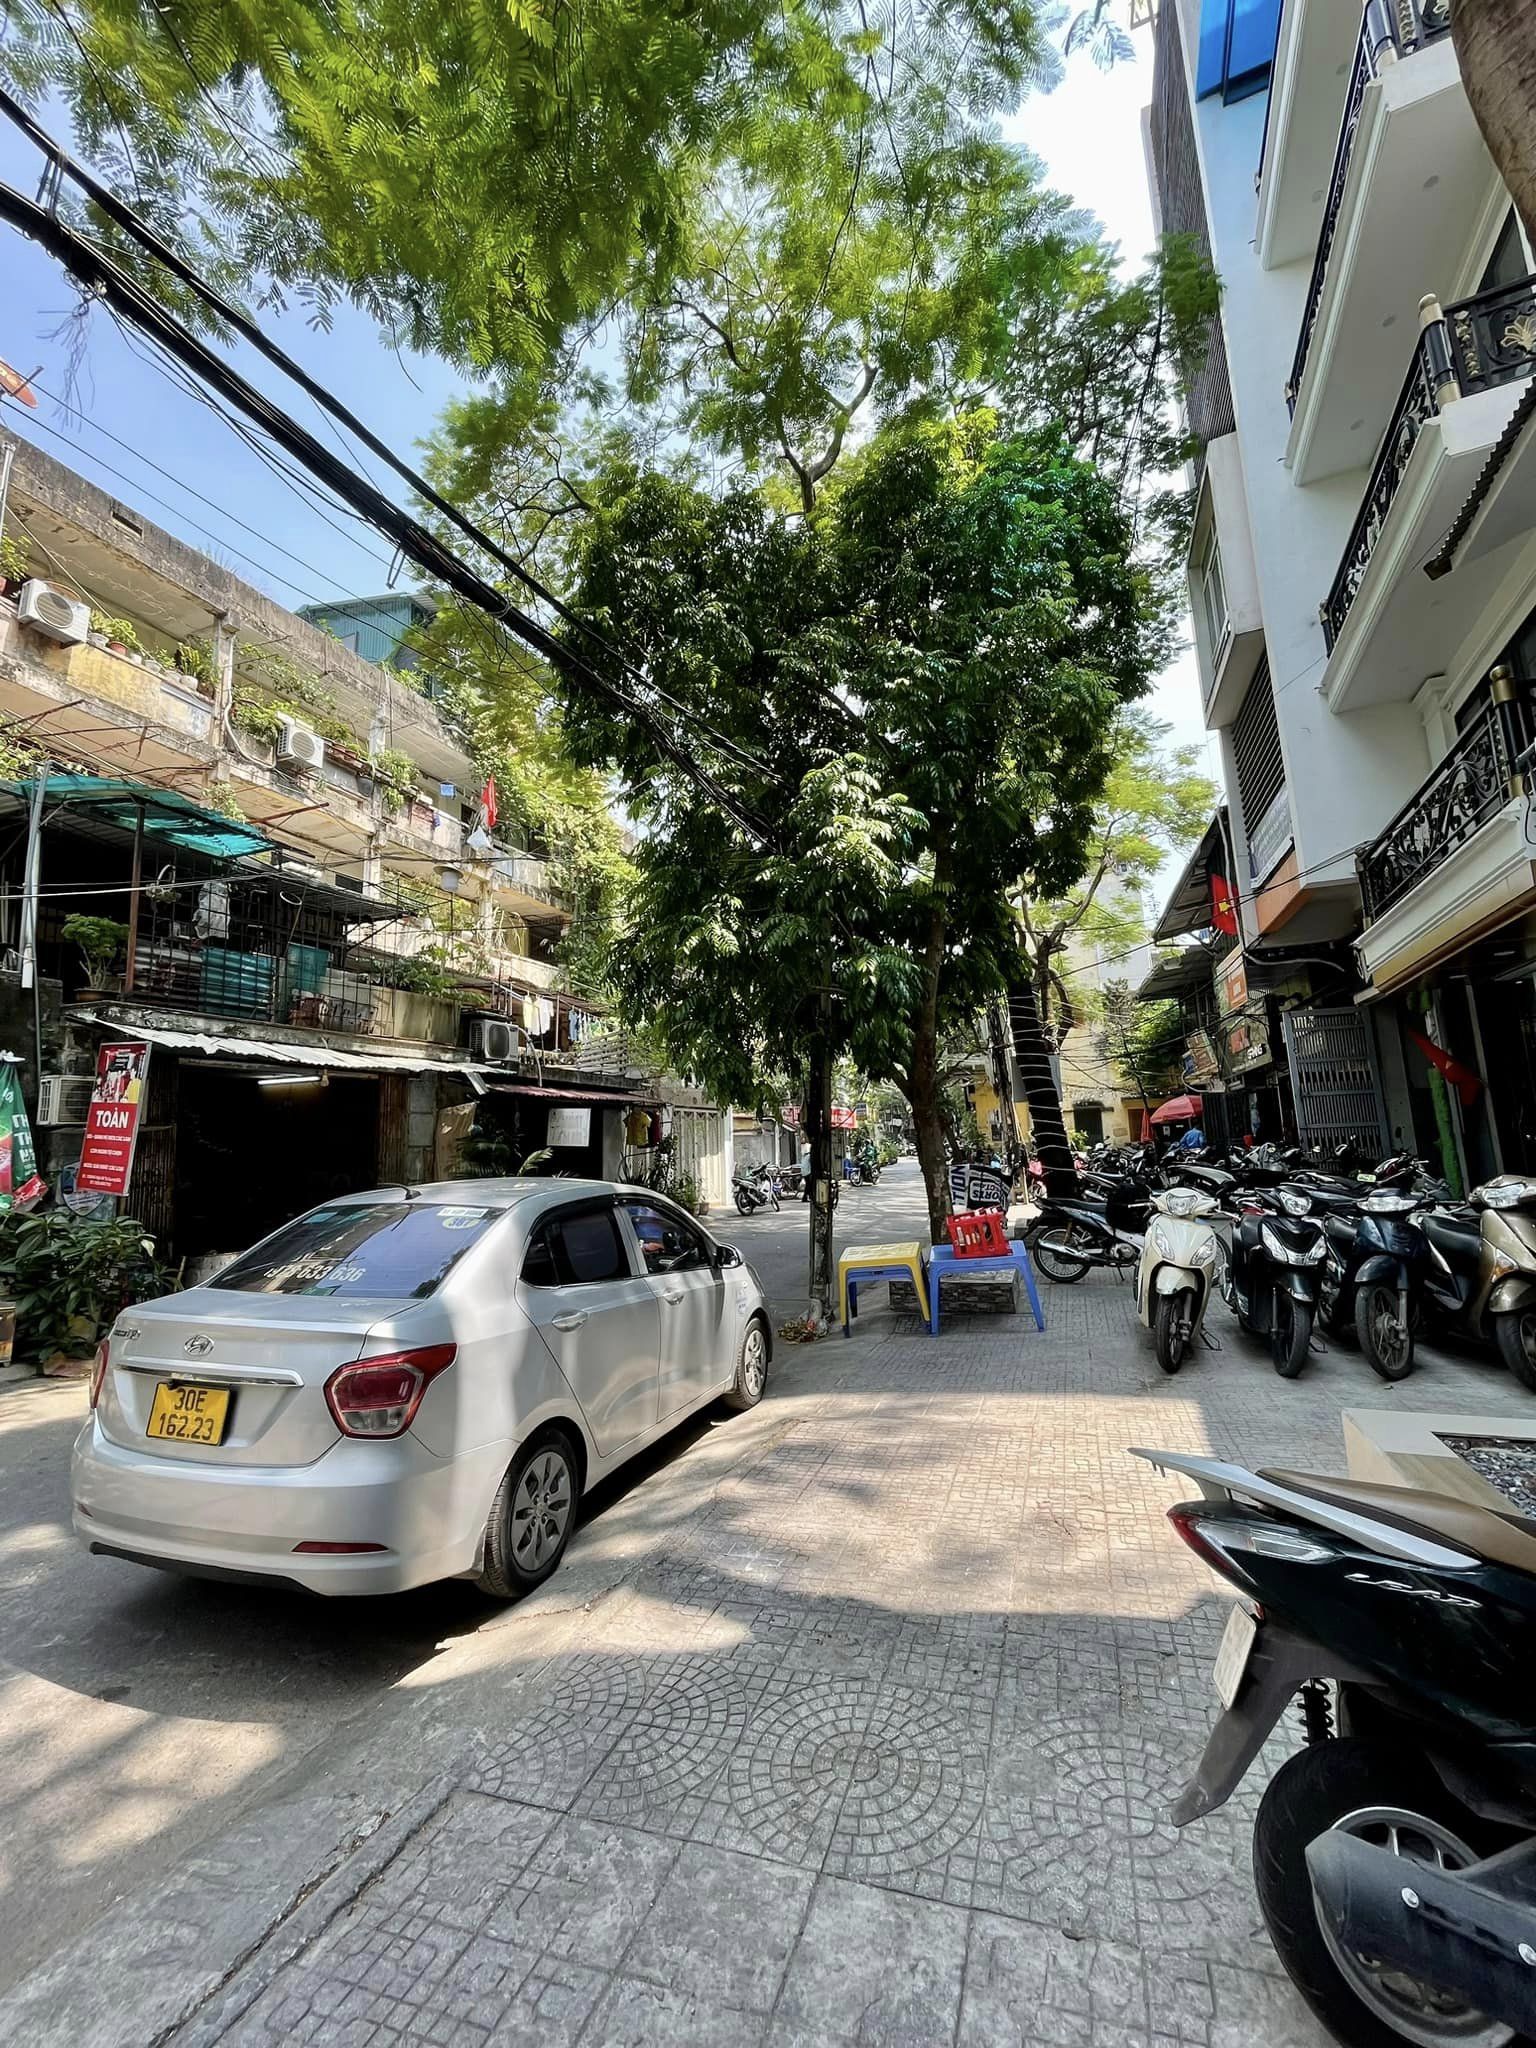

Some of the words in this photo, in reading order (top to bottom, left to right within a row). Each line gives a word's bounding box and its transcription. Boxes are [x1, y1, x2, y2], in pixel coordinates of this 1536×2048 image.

[951, 1165, 966, 1206] TION
[329, 1266, 366, 1282] 636
[174, 1388, 208, 1413] 30E
[159, 1413, 214, 1440] 162.23
[1343, 1572, 1484, 1609] LEAD
